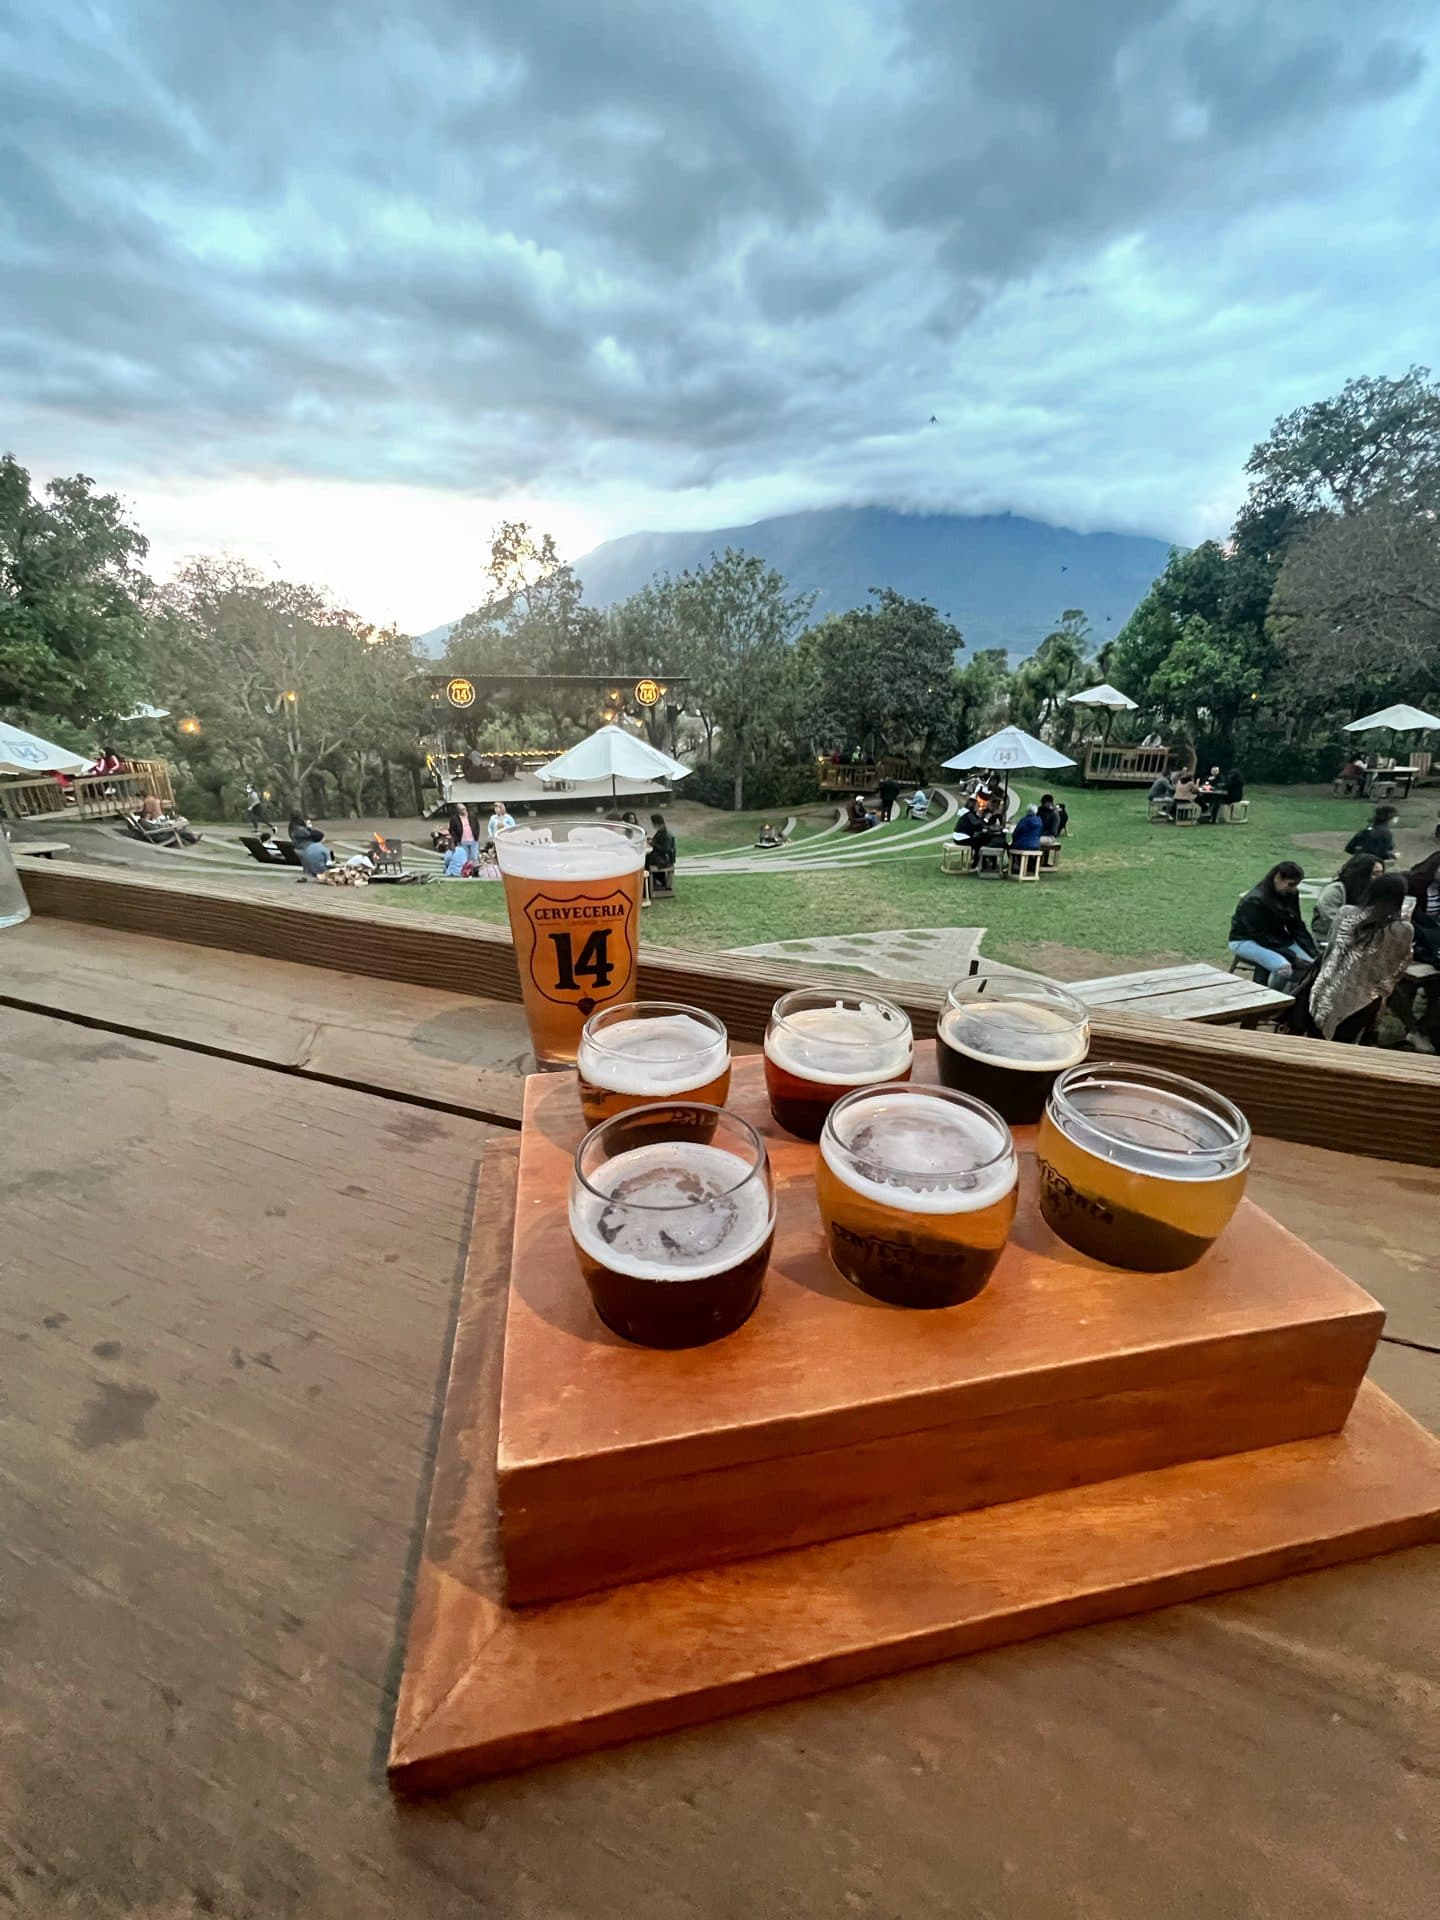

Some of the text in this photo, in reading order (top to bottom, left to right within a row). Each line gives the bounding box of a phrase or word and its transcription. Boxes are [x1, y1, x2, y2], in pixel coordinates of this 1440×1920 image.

[455, 688, 468, 700] 14
[1000, 751, 1011, 760] 14
[534, 904, 625, 921] CERVECERIA
[548, 928, 614, 990] 14
